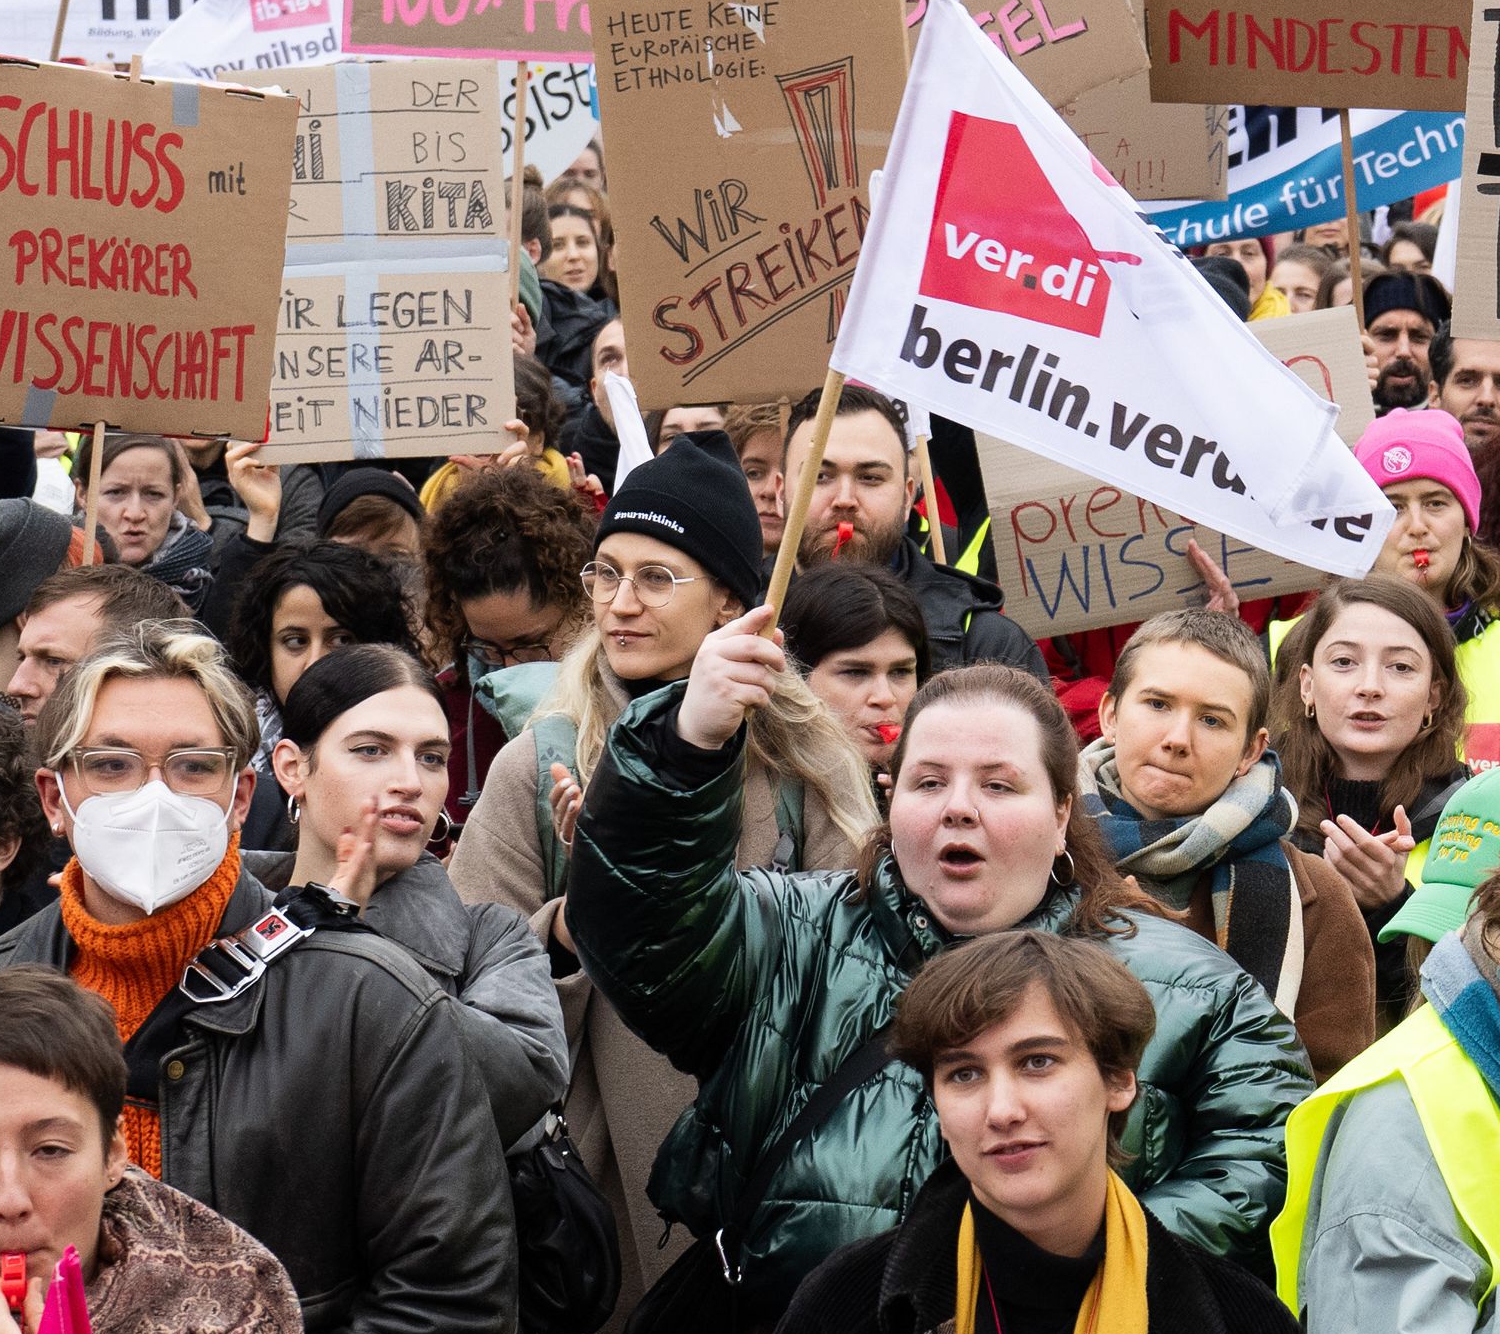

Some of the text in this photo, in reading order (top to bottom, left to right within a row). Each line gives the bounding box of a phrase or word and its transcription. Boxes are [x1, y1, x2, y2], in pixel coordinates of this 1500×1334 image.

[607, 10, 693, 38] HEUTE
[411, 80, 480, 108] DER
[208, 161, 247, 195] mit
[1278, 174, 1344, 215] für
[1352, 118, 1466, 186] Techn
[8, 227, 198, 301] PREKÄRER
[943, 221, 1100, 307] ver.di
[337, 289, 473, 329] LEGEN
[271, 339, 482, 379] NSERE AR-
[614, 511, 685, 534] #nurmitlinks
